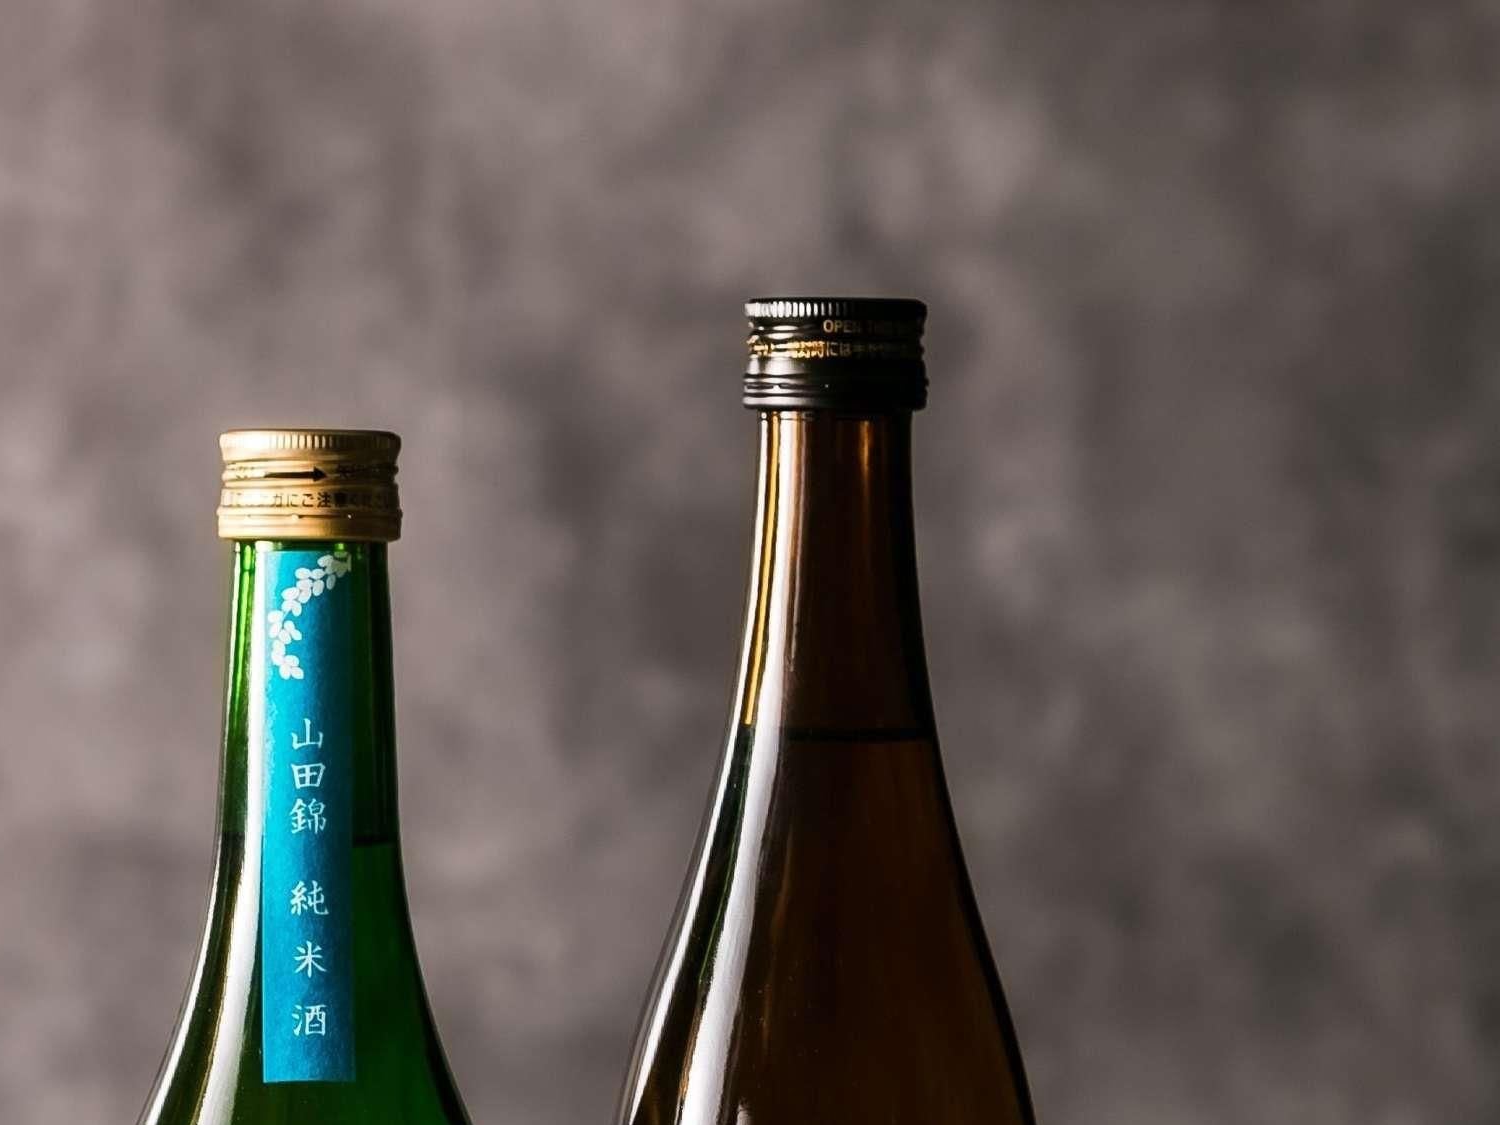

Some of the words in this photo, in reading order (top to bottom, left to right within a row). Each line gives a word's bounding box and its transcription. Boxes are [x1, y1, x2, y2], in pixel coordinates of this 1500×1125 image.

[290, 719, 326, 834] 山田錦
[290, 880, 328, 1037] 純米酒
